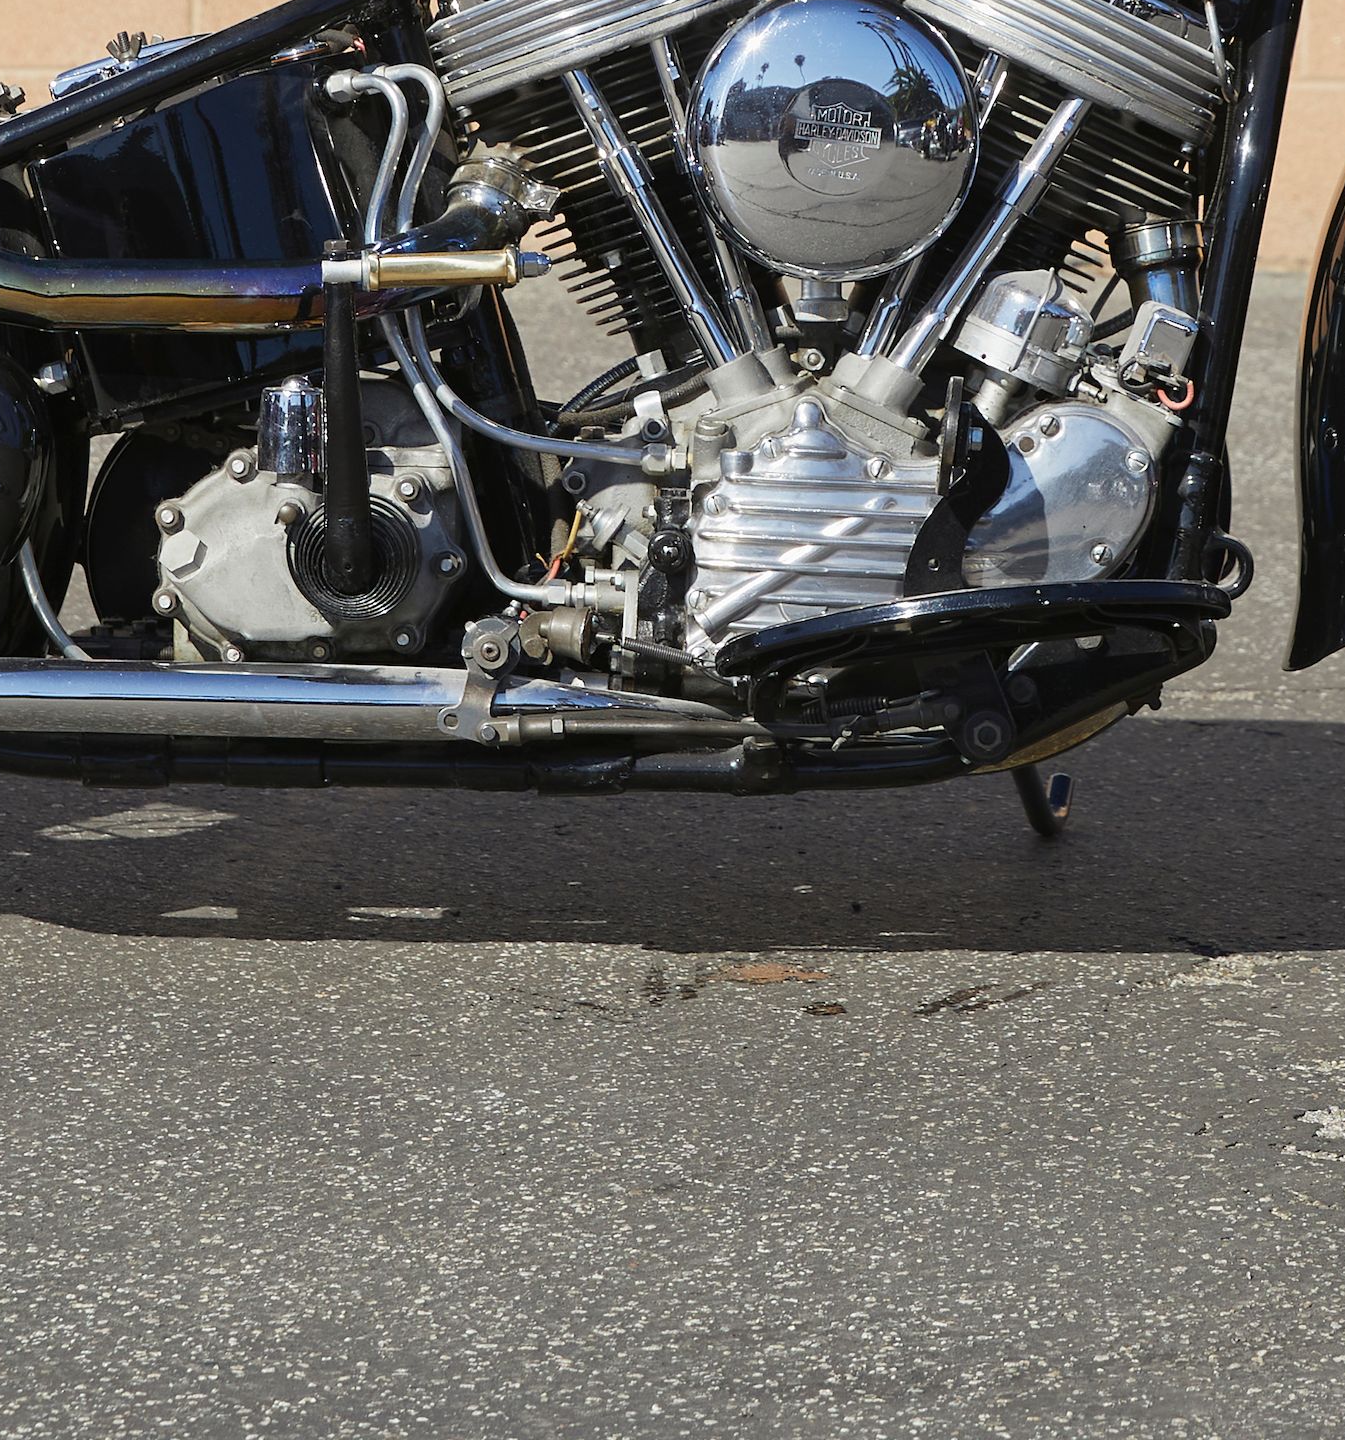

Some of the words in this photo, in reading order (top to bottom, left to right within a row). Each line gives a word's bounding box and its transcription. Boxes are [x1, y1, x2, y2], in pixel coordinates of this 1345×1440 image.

[817, 106, 862, 127] MOTOR
[798, 123, 878, 145] HARLEY-DAVIDSON
[811, 143, 859, 164] CYCLES
